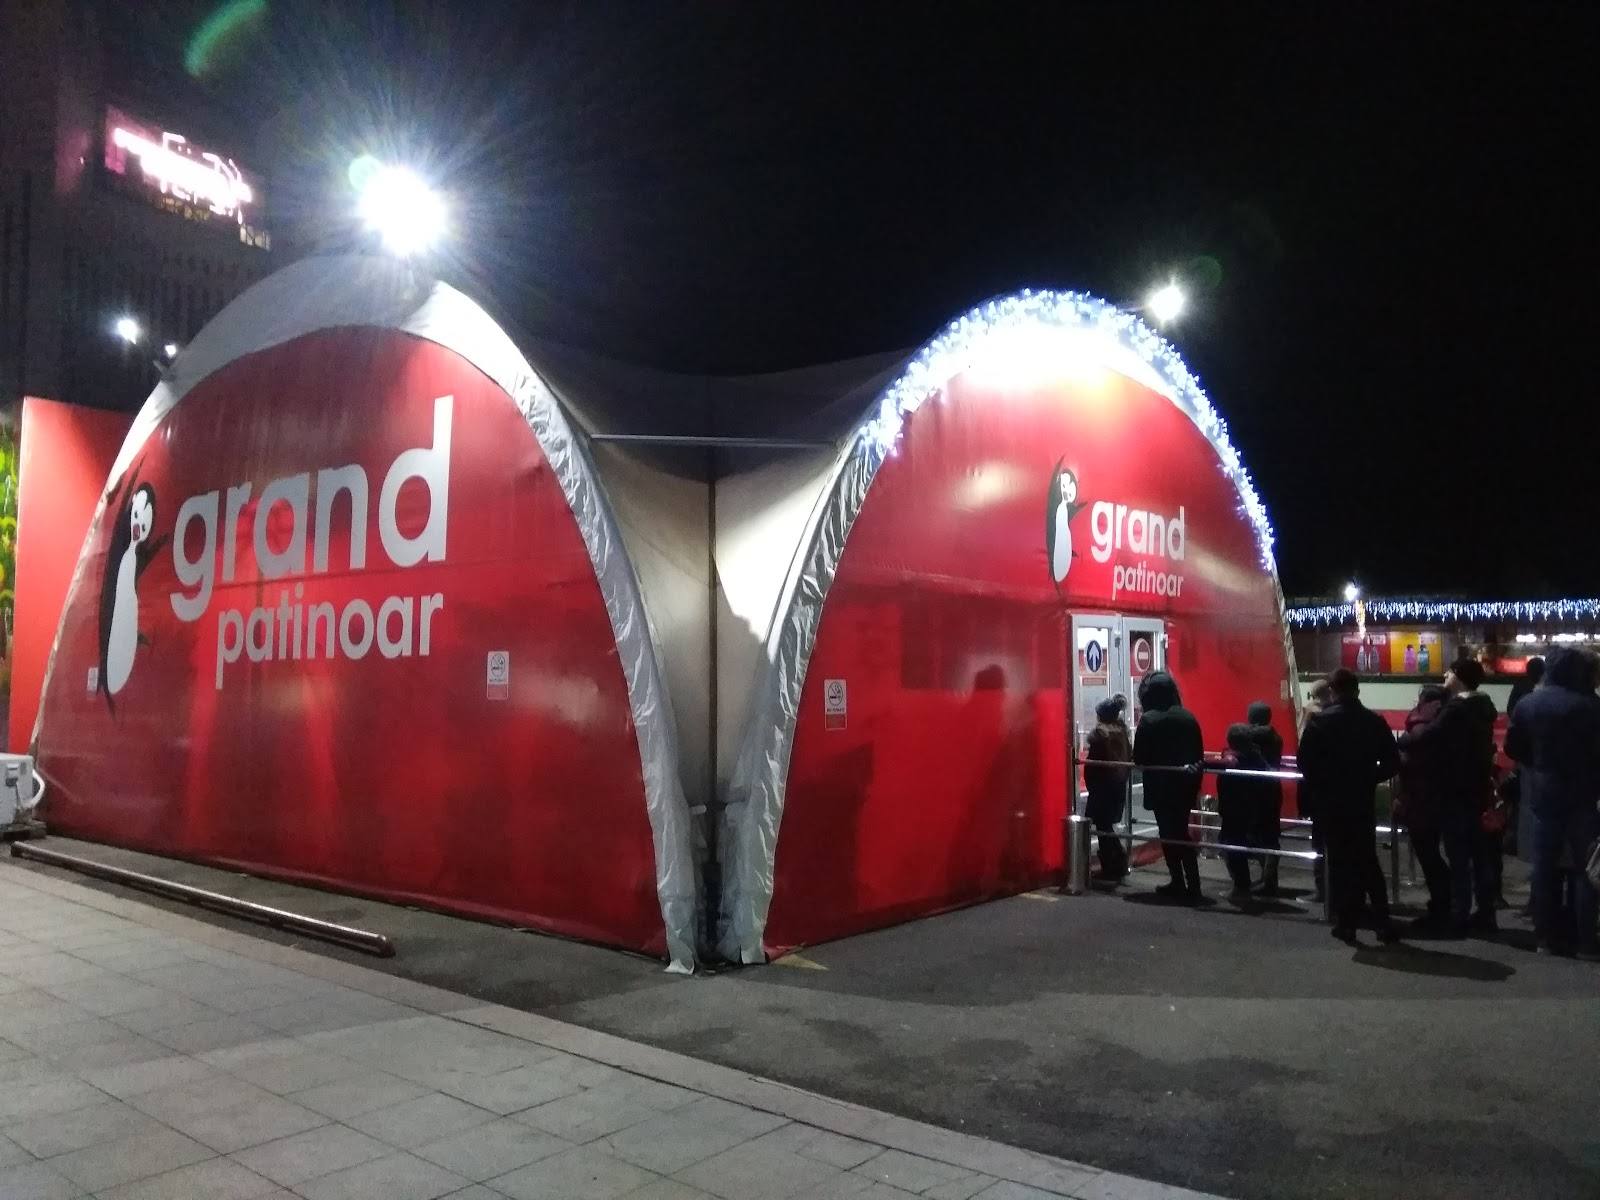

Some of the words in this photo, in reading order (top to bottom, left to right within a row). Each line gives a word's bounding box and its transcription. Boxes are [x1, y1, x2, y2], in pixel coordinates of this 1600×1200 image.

[169, 395, 454, 622] grand
[1091, 500, 1185, 564] grand
[1112, 560, 1184, 601] patinoar
[215, 582, 444, 690] patinoar
